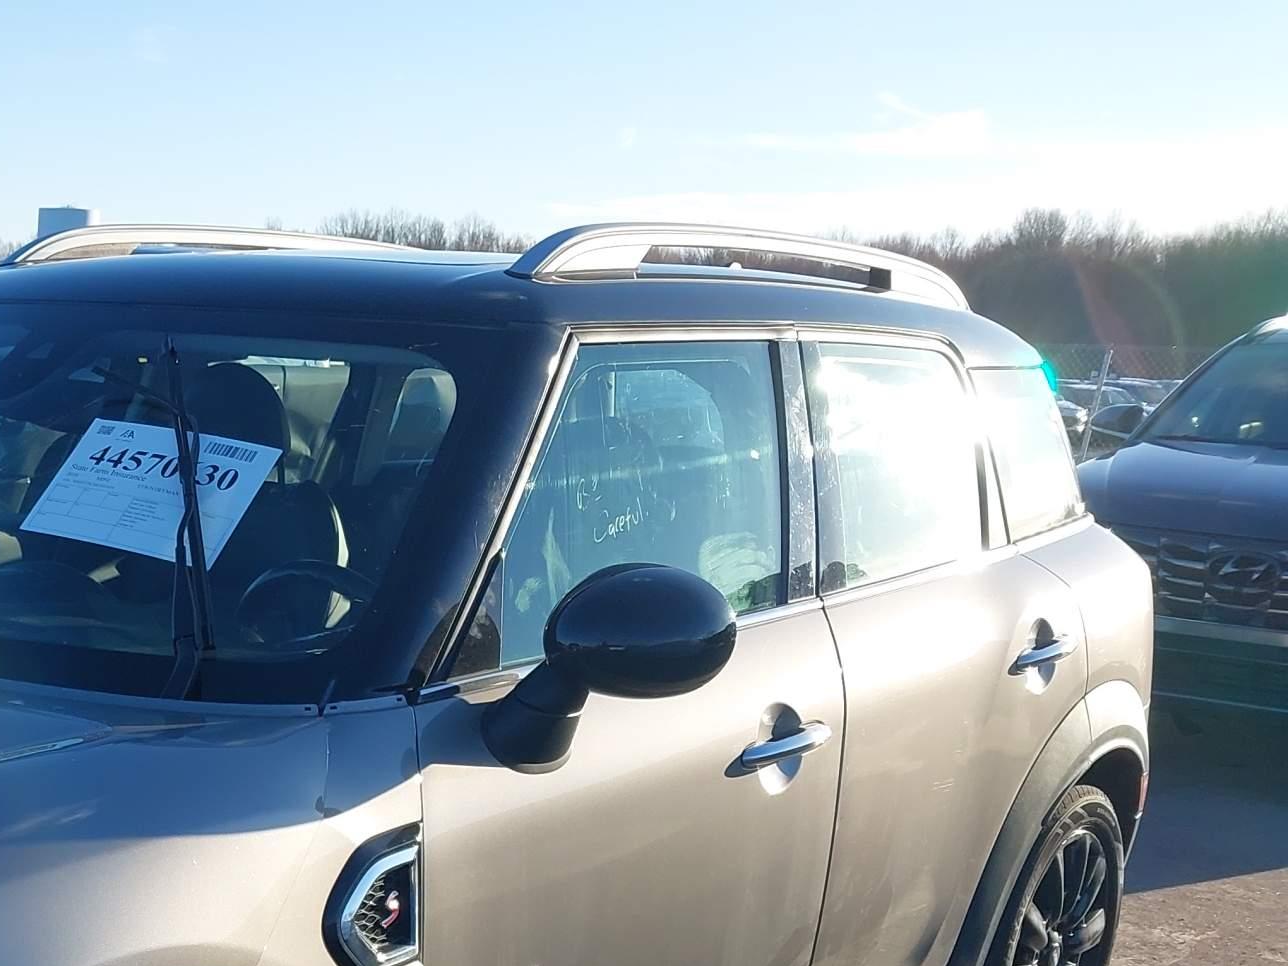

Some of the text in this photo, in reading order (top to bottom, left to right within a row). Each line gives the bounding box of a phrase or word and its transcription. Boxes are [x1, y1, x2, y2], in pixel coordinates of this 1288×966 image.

[89, 445, 240, 491] 4457030
[89, 466, 109, 476] Farm
[111, 470, 147, 482] Insurance
